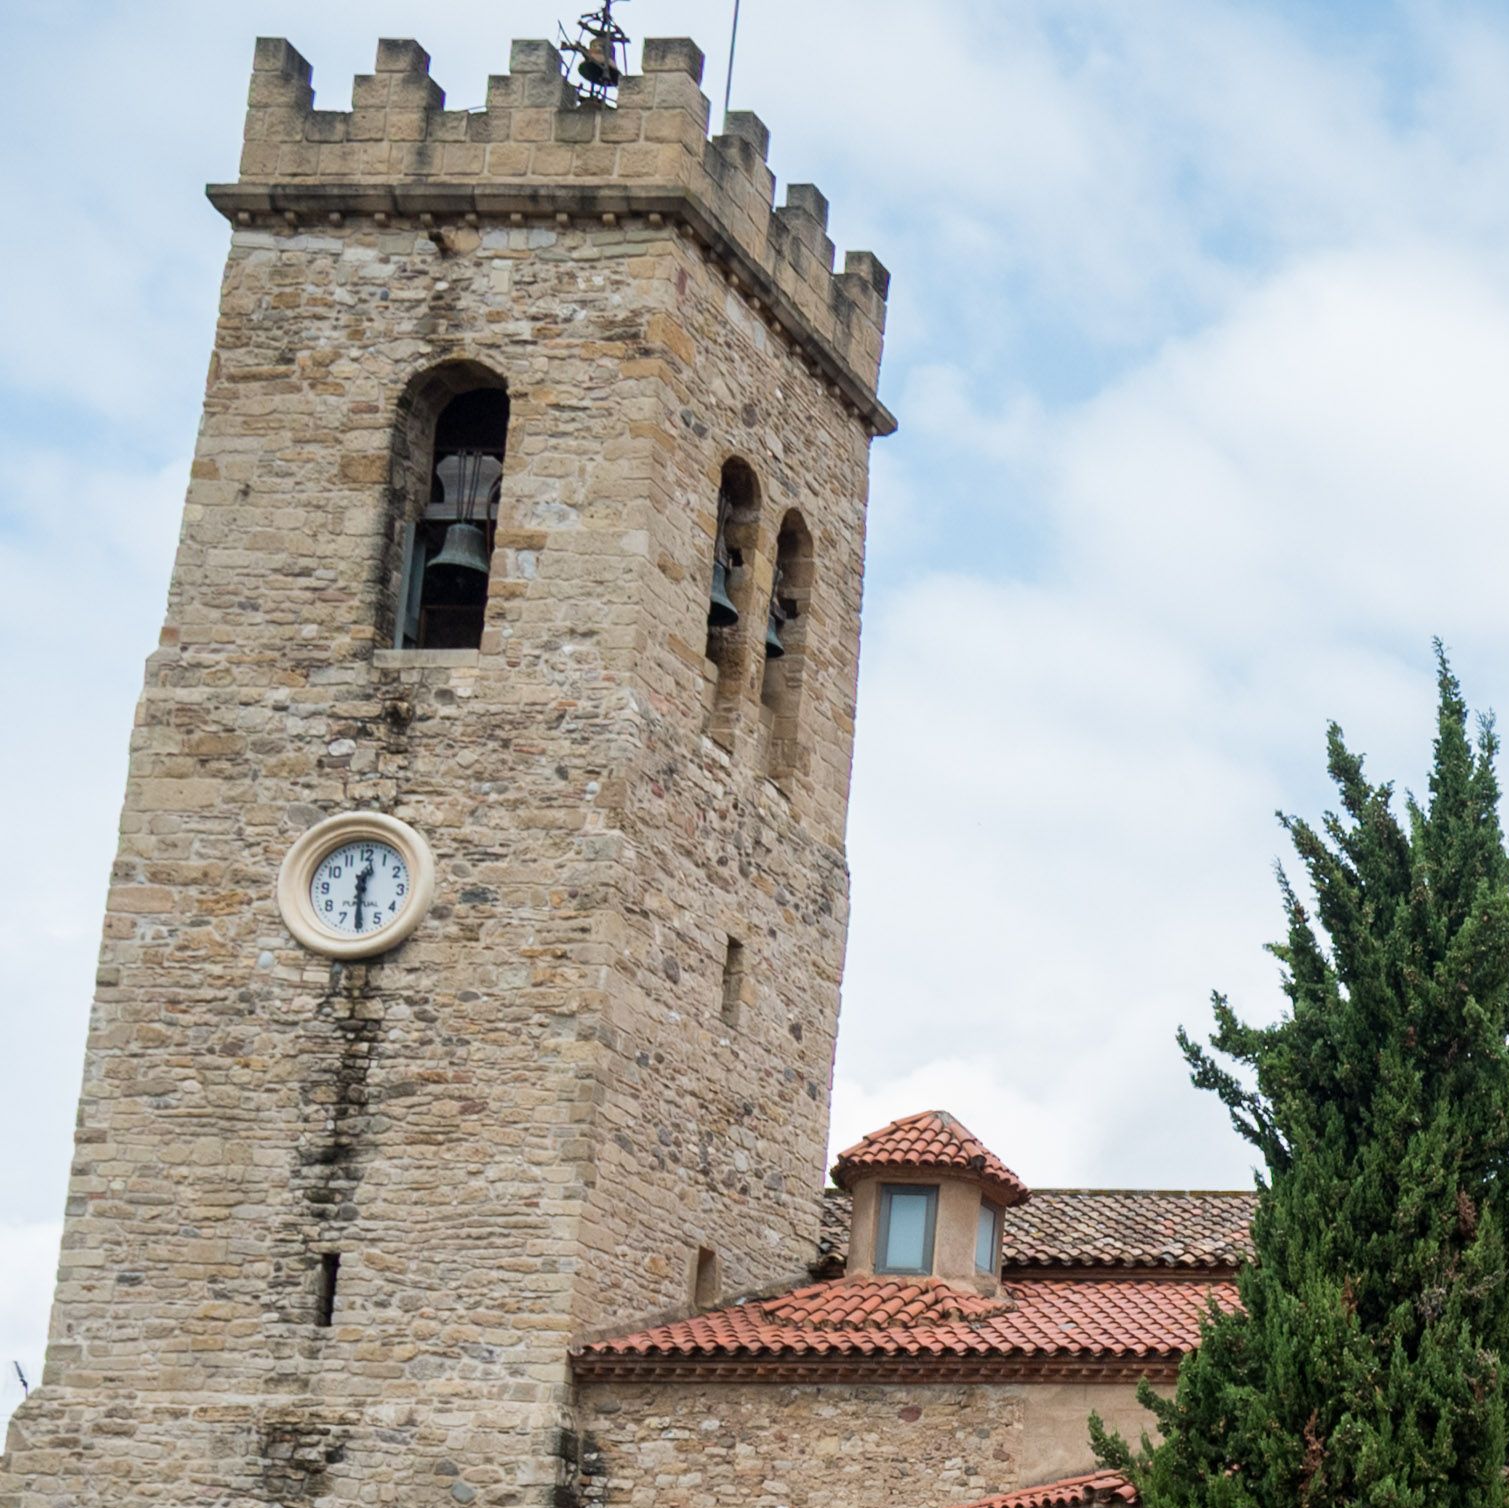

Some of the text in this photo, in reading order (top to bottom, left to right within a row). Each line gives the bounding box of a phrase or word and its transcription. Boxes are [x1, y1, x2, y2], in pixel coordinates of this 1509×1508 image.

[345, 854, 353, 867] 11
[361, 848, 374, 862] 12
[329, 866, 342, 879] 10
[392, 866, 401, 879] 2
[321, 882, 330, 895] 9
[396, 883, 405, 896] 3
[325, 899, 333, 912] 8
[388, 900, 396, 912] 4
[339, 912, 347, 924] 7
[373, 912, 382, 925] 5
